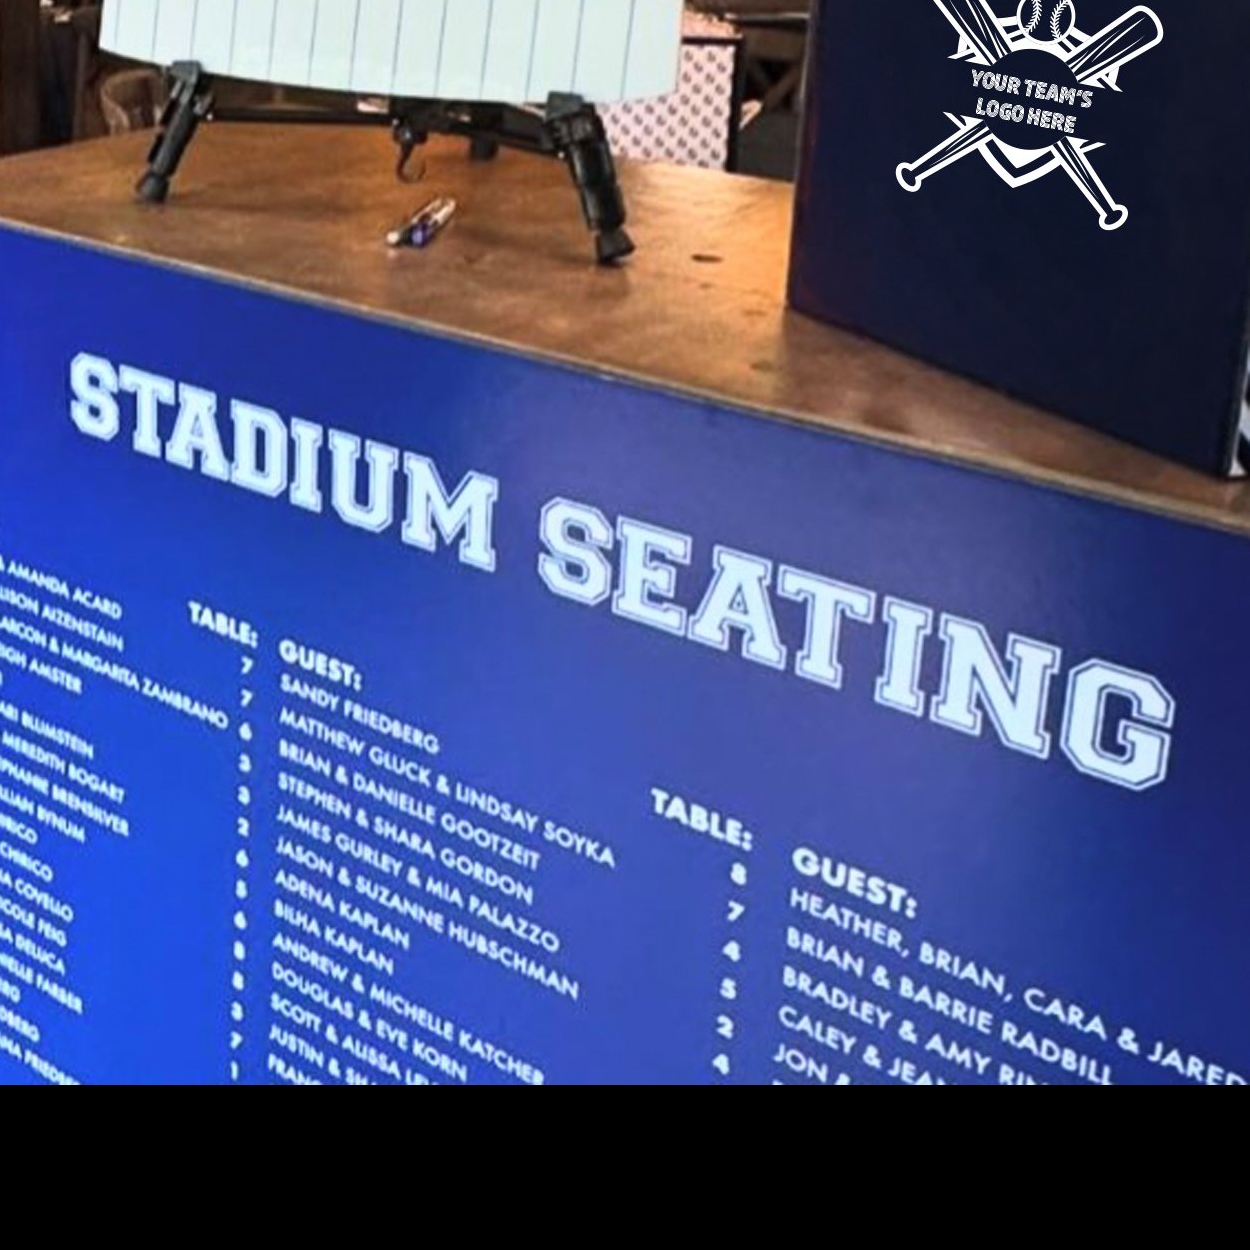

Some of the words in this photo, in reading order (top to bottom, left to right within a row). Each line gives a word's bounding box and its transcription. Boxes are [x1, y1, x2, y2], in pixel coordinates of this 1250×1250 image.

[8, 561, 69, 599] AMANDA
[70, 352, 498, 572] STADIUM
[537, 496, 1174, 791] SEATING
[189, 601, 258, 648] TABLE:
[241, 689, 253, 706] 7
[242, 656, 253, 673] 7
[279, 639, 361, 691] GUEST:
[142, 678, 228, 729] ZAMBRANO
[281, 674, 339, 710] SANDY
[344, 700, 439, 754] FRIEDBERG
[280, 707, 365, 755] MATTHEW
[369, 746, 430, 787] GLUCK
[436, 775, 450, 795] &
[456, 783, 538, 832] LINDSAY
[544, 821, 614, 867] SOYKA
[280, 739, 330, 776] BRIAN
[335, 766, 348, 785] &
[354, 773, 435, 824] DANIELLE
[441, 813, 540, 869] GOOTZEIT
[651, 788, 752, 851] TABLE:
[279, 772, 351, 818] STEPHEN
[356, 809, 368, 828] &
[375, 817, 435, 859] SHARA
[441, 848, 533, 904] GORDON
[277, 805, 332, 844] JAMES
[334, 833, 402, 876] GURLEY
[407, 867, 420, 887] &
[426, 877, 463, 907] MIA
[469, 895, 559, 952] PALAZZO
[731, 863, 746, 885] 8
[793, 848, 917, 918] GUEST:
[275, 870, 334, 911] ADENA
[340, 901, 409, 949] KAPLAN
[275, 900, 320, 937] BILHA
[325, 926, 393, 975] KAPLAN
[277, 837, 333, 877] JASON
[338, 868, 350, 886] &
[356, 876, 443, 933] SUZANNE
[449, 921, 578, 999] HUBSCHMAN
[728, 901, 744, 921] 7
[723, 941, 740, 961] 4
[273, 933, 348, 981] ANDREW
[352, 974, 364, 993] &
[370, 984, 453, 1041] MICHELLE
[459, 1030, 544, 1085] KATCHER
[720, 978, 736, 999] 5
[787, 927, 864, 976] BRIAN
[872, 966, 890, 989] &
[900, 976, 992, 1034] BARRIE
[1002, 1021, 1113, 1085] RADBILL
[791, 888, 909, 957] HEATHER,
[920, 942, 1012, 1002] BRIAN,
[1024, 988, 1107, 1040] CARA
[1117, 1028, 1139, 1054] &
[1148, 1042, 1247, 1085] JARED
[269, 1025, 324, 1067] JUSTIN
[328, 1058, 340, 1078] &
[271, 993, 321, 1032] SCOTT
[325, 1024, 339, 1045] &
[342, 1035, 402, 1080] ALISSA
[272, 962, 353, 1019] DOUGLAS
[358, 1010, 371, 1030] &
[376, 1019, 407, 1050] EVE
[413, 1039, 467, 1083] KORN
[717, 1015, 733, 1038] 2
[779, 1006, 856, 1054] CALEY
[863, 1045, 881, 1068] &
[783, 966, 892, 1029] BRADLEY
[899, 1020, 917, 1043] &
[925, 1034, 991, 1074] AMY
[713, 1054, 729, 1074] 4
[774, 1044, 828, 1083] JON
